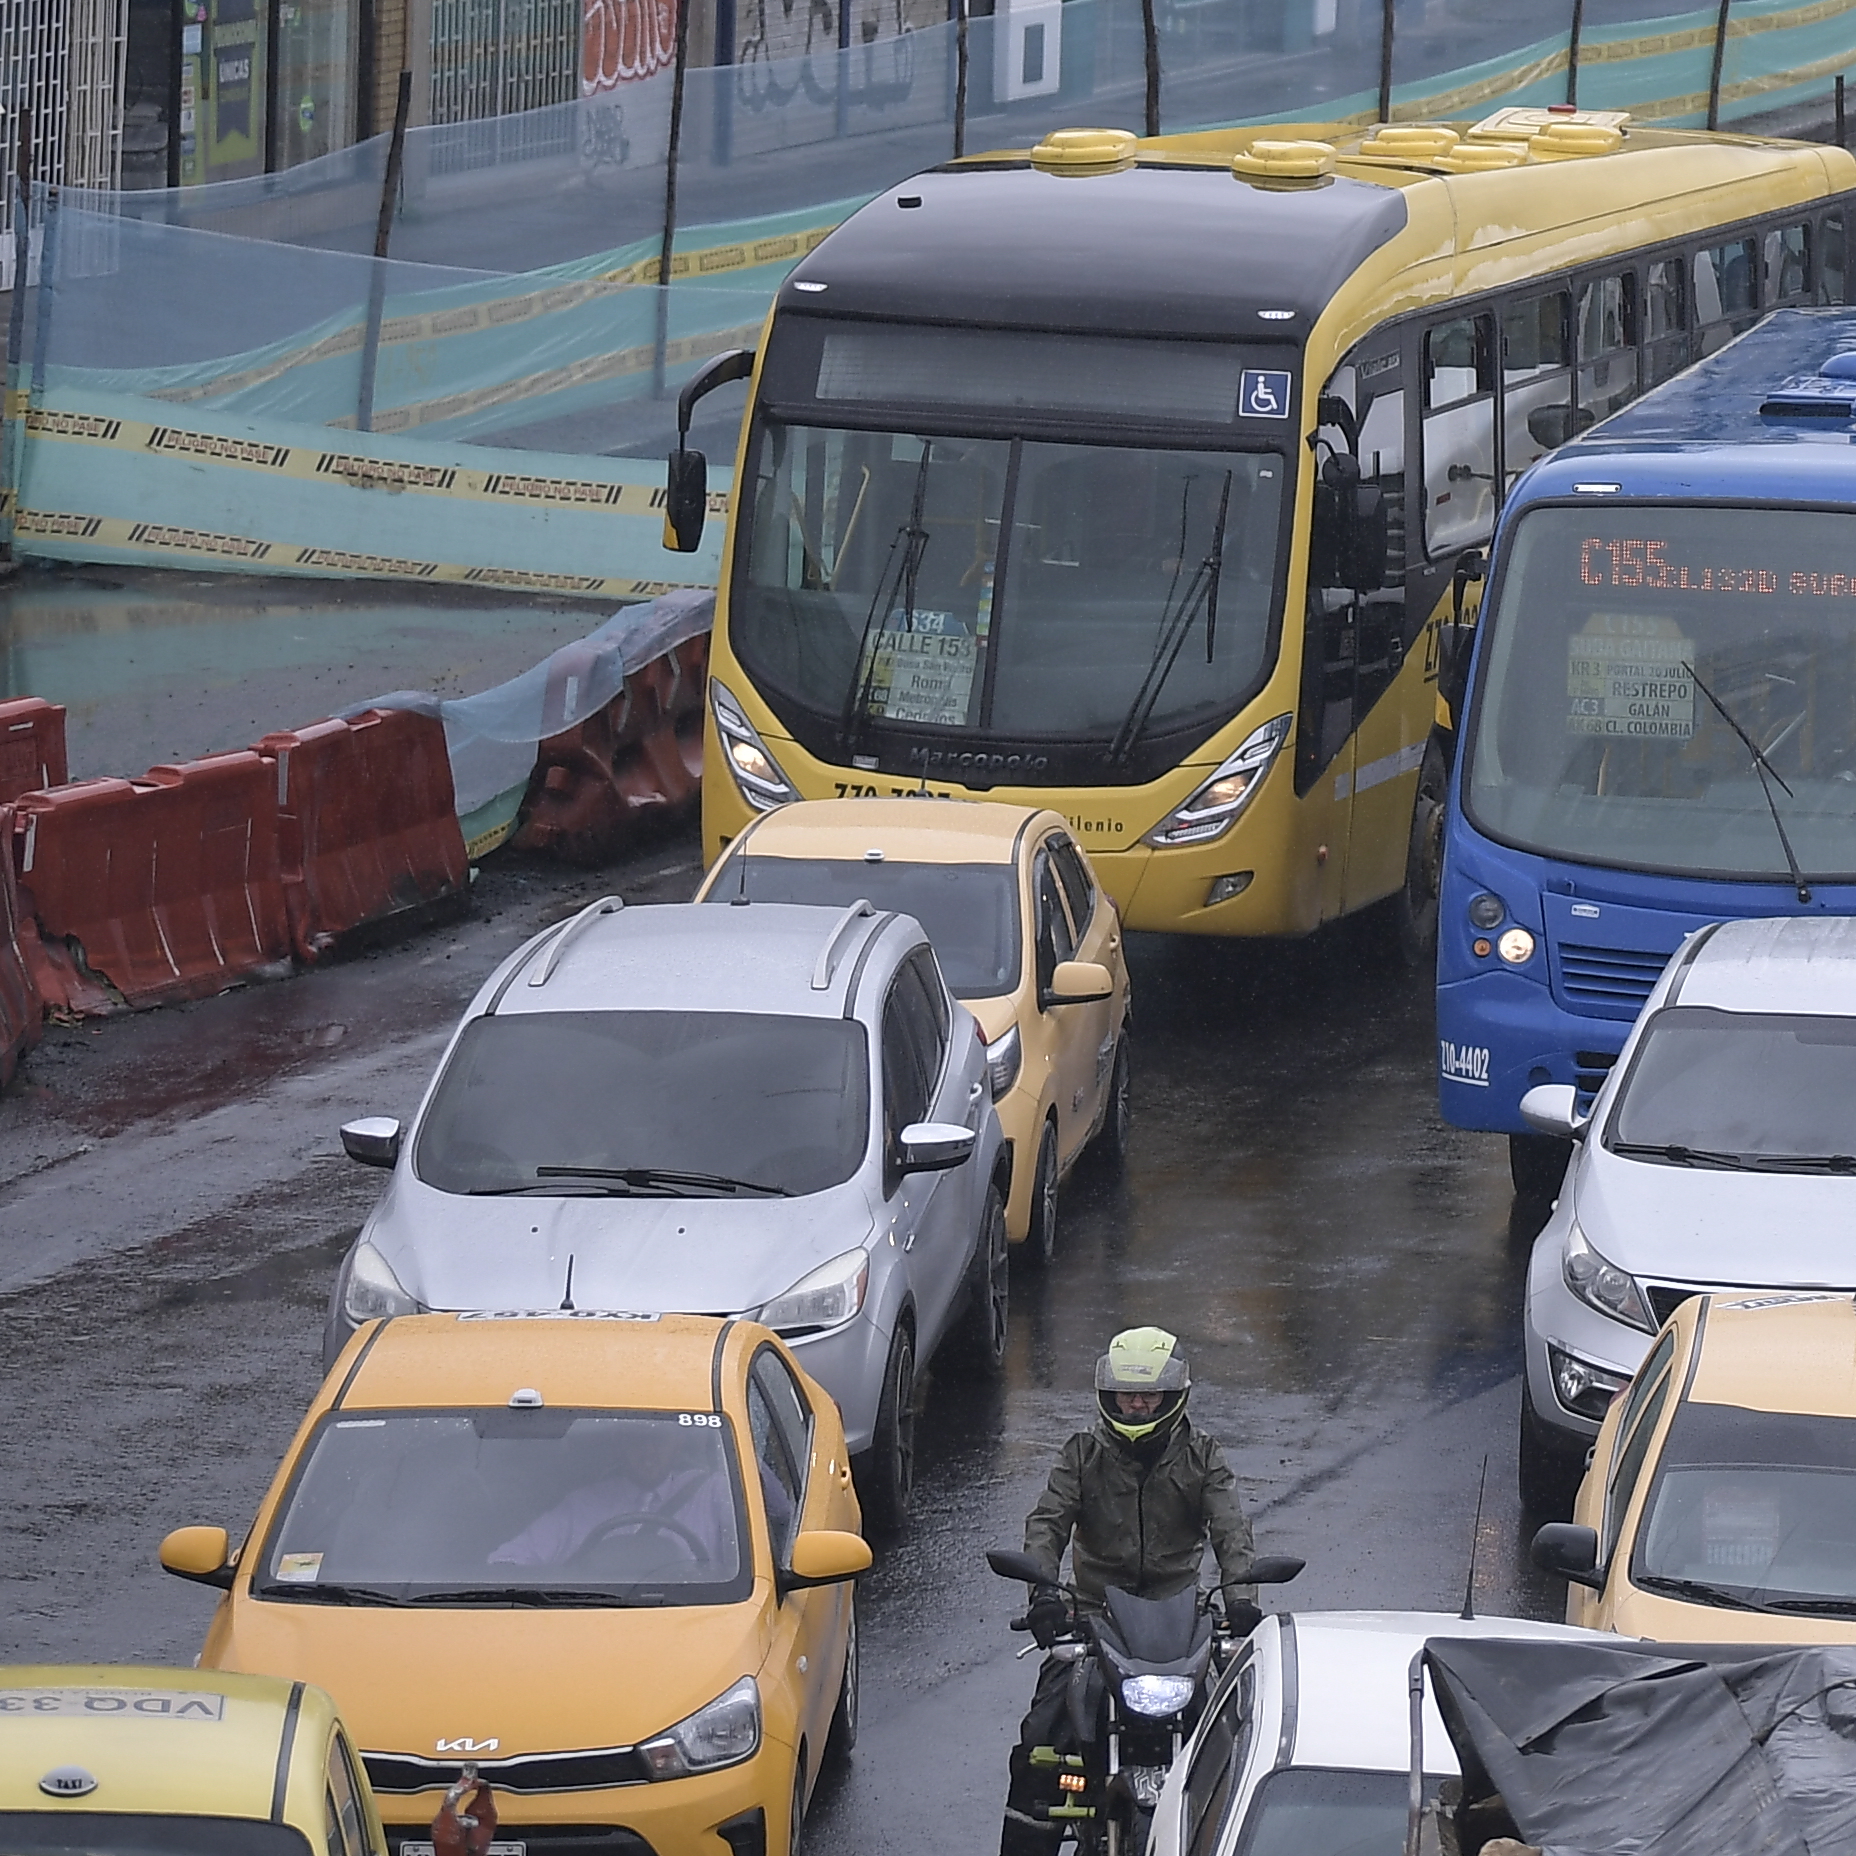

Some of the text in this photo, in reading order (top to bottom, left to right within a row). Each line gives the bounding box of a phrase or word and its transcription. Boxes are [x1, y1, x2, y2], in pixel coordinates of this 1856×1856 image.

[72, 420, 100, 434] PASE
[167, 434, 270, 460] PELIGRO NO PASE
[387, 466, 406, 478] NO
[408, 469, 437, 483] PASE
[502, 481, 603, 500] PELIGRO NO PASE
[1581, 537, 1667, 587] C155
[872, 630, 933, 654] CALLE
[1612, 681, 1688, 699] RESTREPO
[1628, 701, 1671, 717] GALÁN
[1605, 720, 1624, 734] CL.
[1627, 721, 1692, 736] COLOMBIA
[910, 746, 1048, 771] Marcopolo
[1063, 815, 1123, 833] ilenio
[678, 1413, 722, 1428] 898
[84, 1696, 214, 1716] VDQ
[436, 1738, 499, 1751] KIA
[56, 1778, 83, 1790] TAXI
